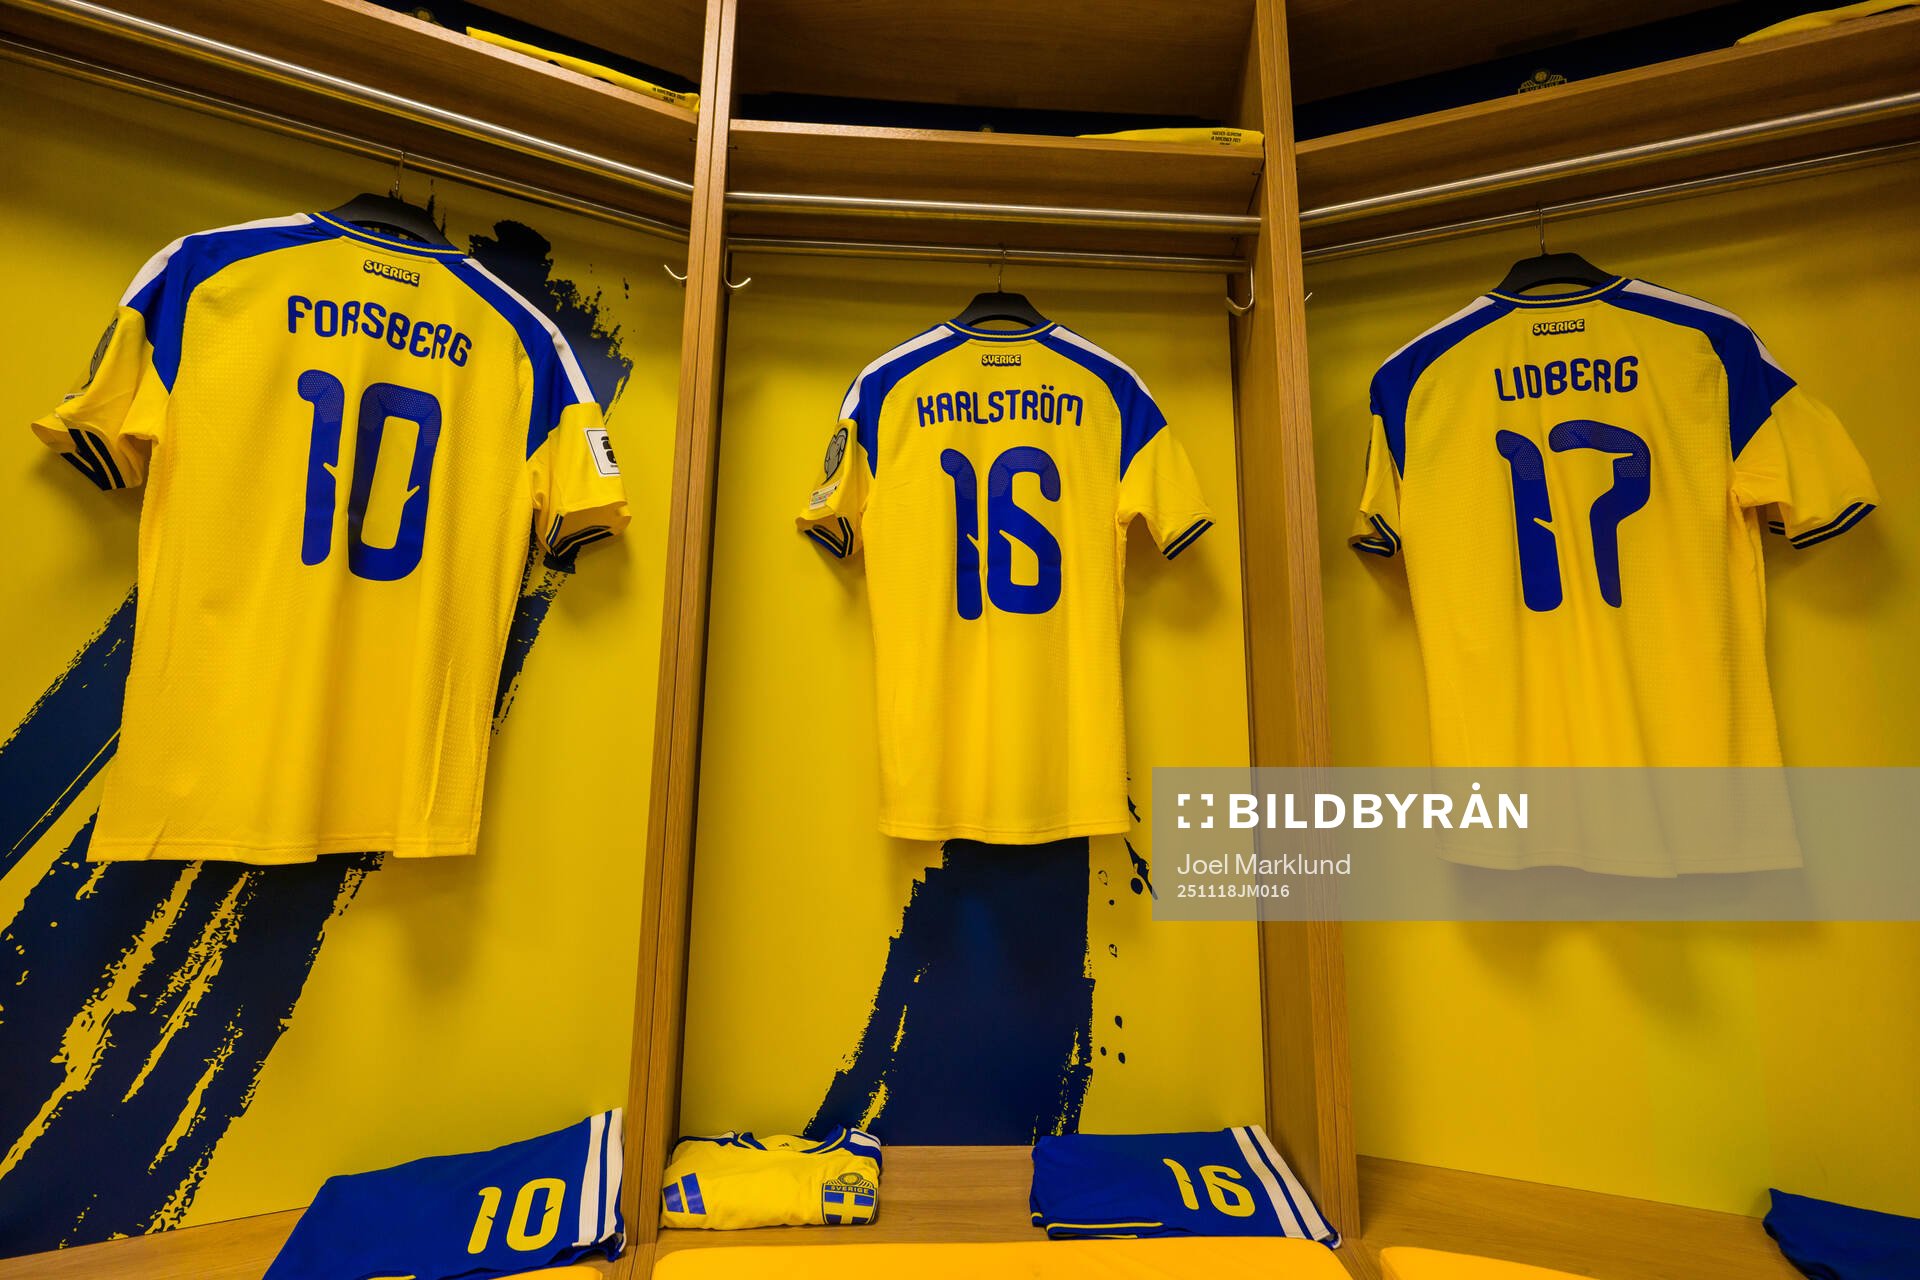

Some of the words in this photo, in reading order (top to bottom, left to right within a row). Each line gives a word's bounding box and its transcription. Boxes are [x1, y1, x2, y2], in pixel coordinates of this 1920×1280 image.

[363, 260, 420, 287] SVERIGE
[287, 294, 473, 367] FORSBERG
[1533, 318, 1585, 336] SVERIGE
[981, 354, 1022, 366] SVERIGE
[1494, 355, 1639, 401] LIDBERG
[916, 384, 1083, 427] KARLSTRÖM
[297, 369, 442, 581] 10
[940, 446, 1062, 620] 16
[1495, 419, 1651, 612] 17
[831, 1186, 869, 1194] SVERIGE
[1162, 1158, 1256, 1217] 16
[467, 1177, 567, 1255] 10
